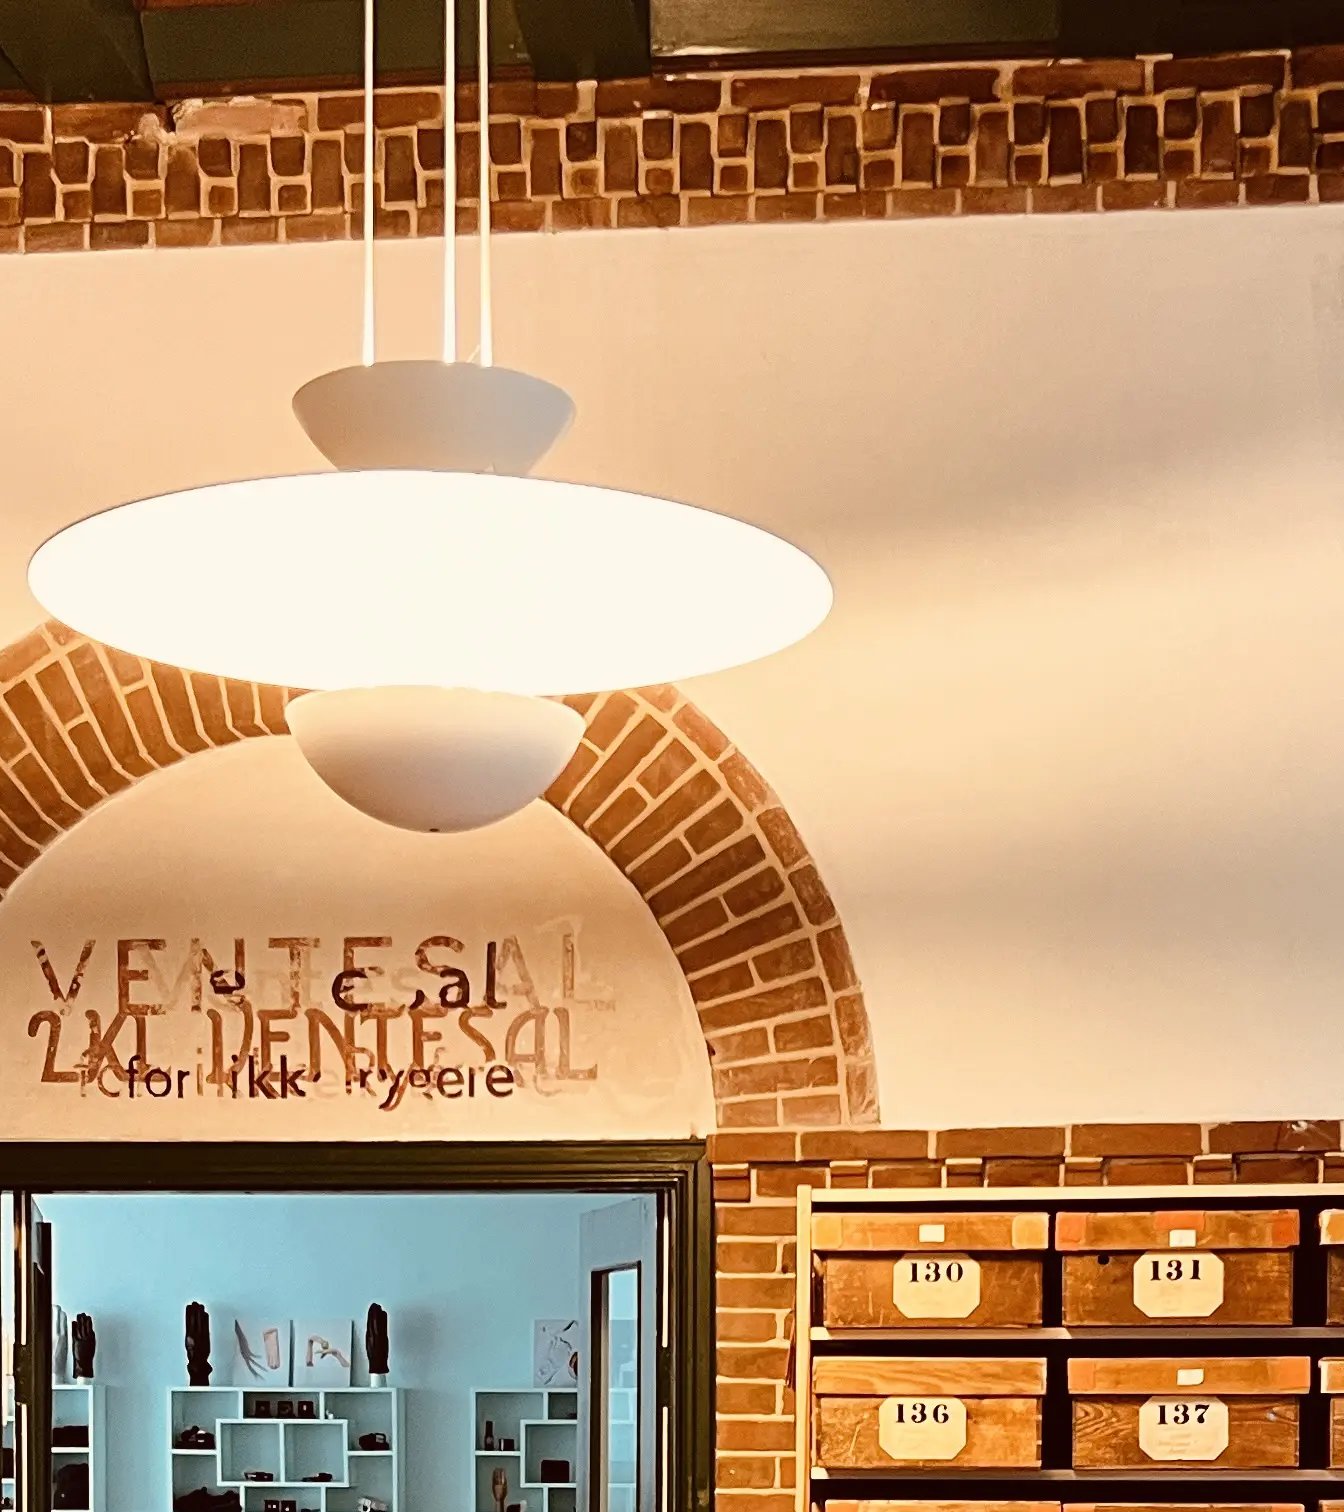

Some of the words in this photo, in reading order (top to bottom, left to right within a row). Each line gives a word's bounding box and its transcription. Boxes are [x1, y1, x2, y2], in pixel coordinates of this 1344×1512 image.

[909, 1262, 964, 1283] 130
[1149, 1260, 1202, 1281] 131
[896, 1403, 950, 1424] 136
[1157, 1403, 1210, 1425] 137
